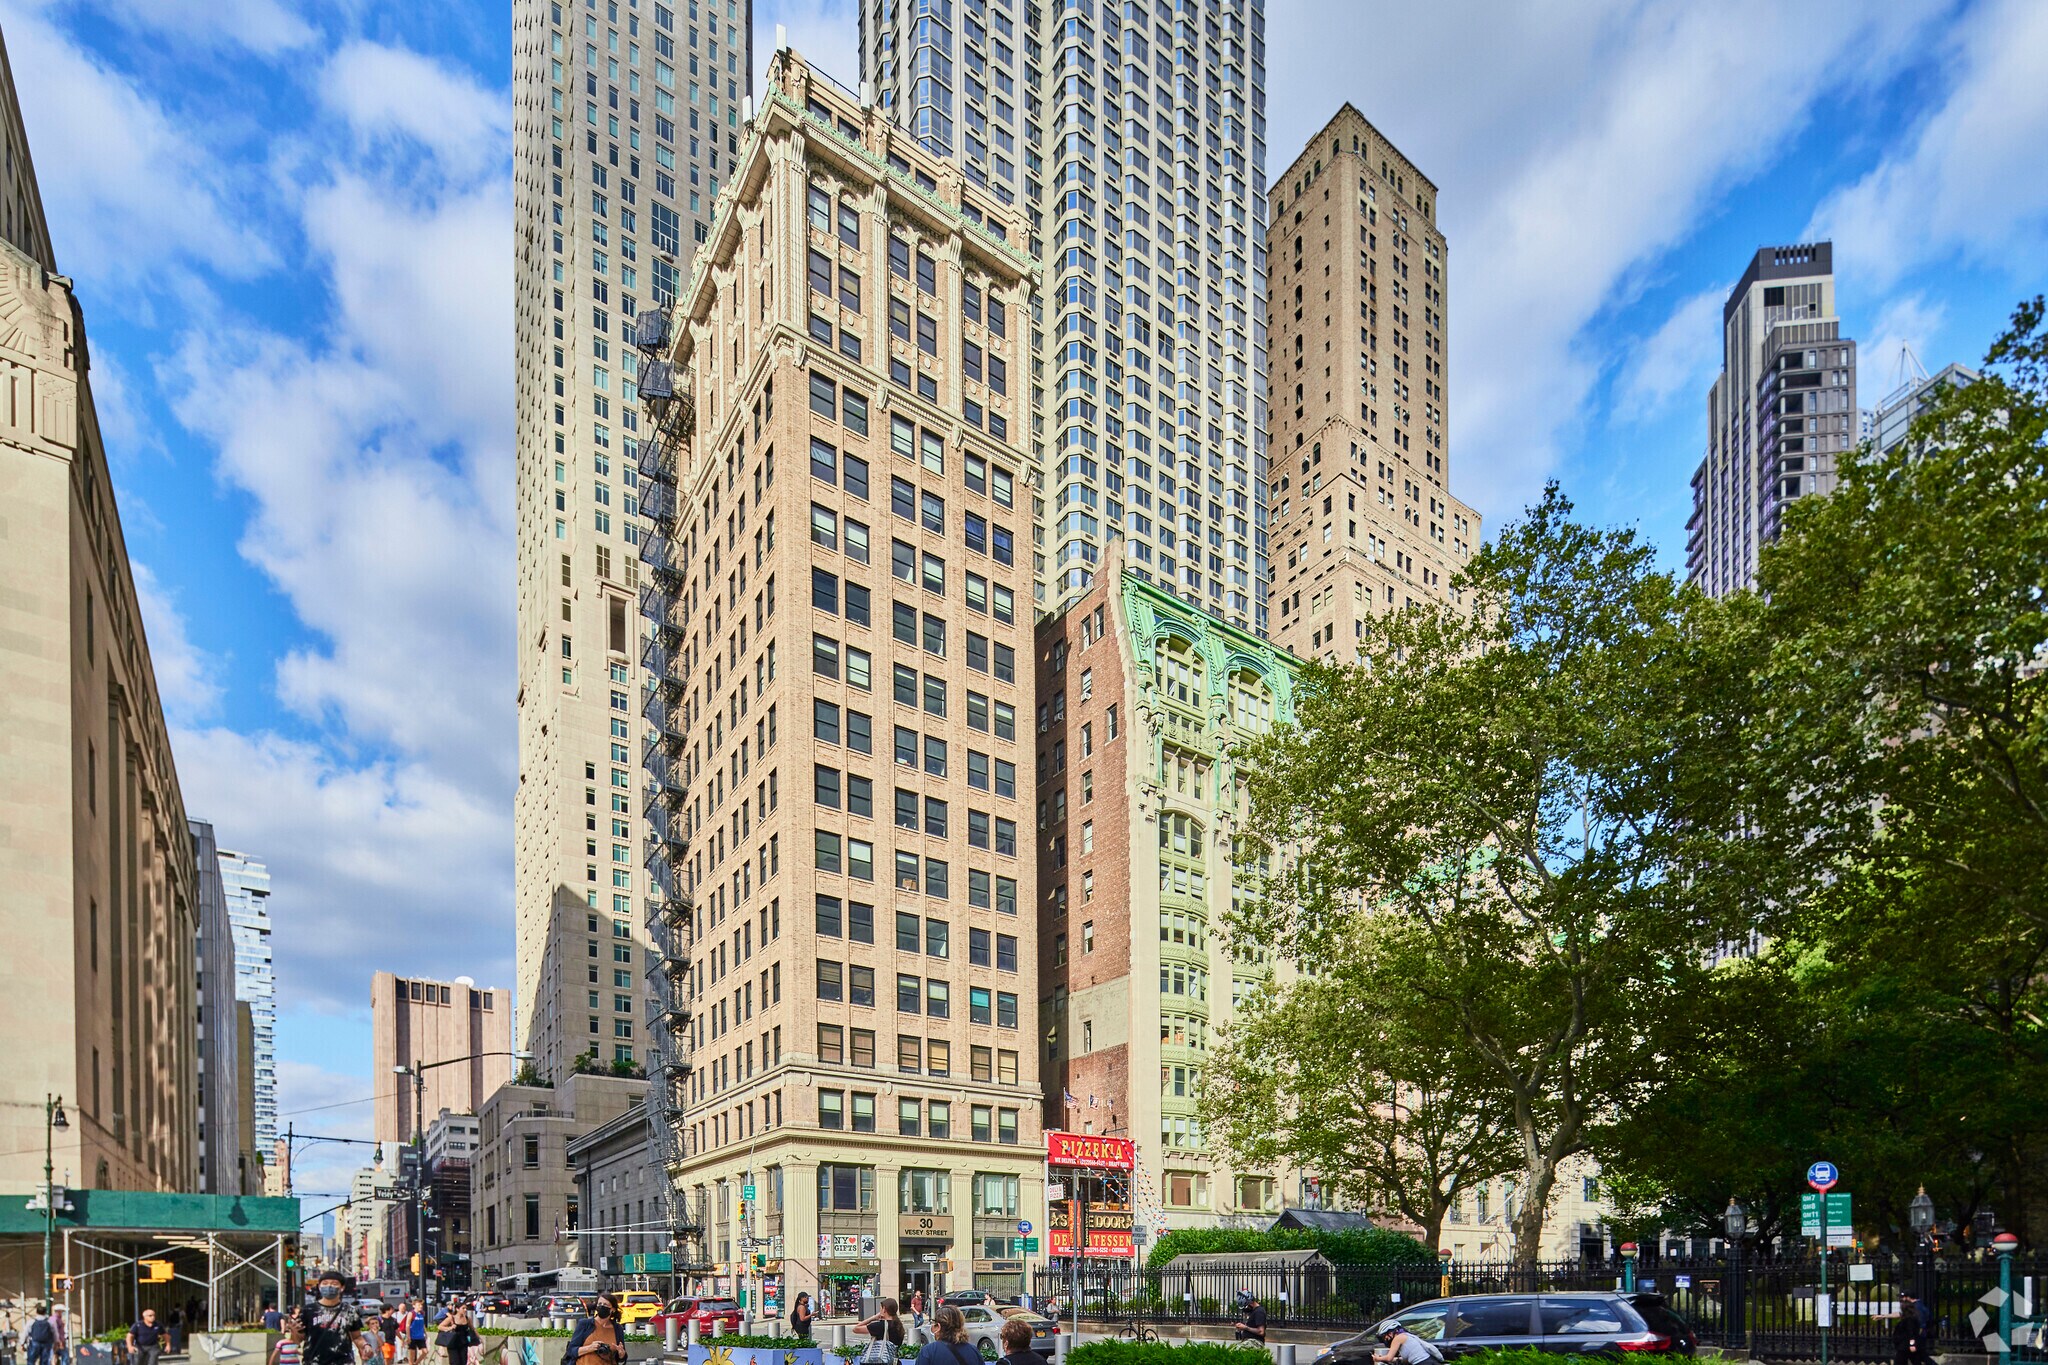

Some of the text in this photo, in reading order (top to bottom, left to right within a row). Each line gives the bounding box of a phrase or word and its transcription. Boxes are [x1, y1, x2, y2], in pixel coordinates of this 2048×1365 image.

[1061, 1140, 1123, 1159] PIZZERIA
[920, 1218, 933, 1228] 30
[1096, 1215, 1125, 1229] DOOR
[834, 1236, 849, 1244] NY
[1053, 1234, 1131, 1247] DEATESSEN
